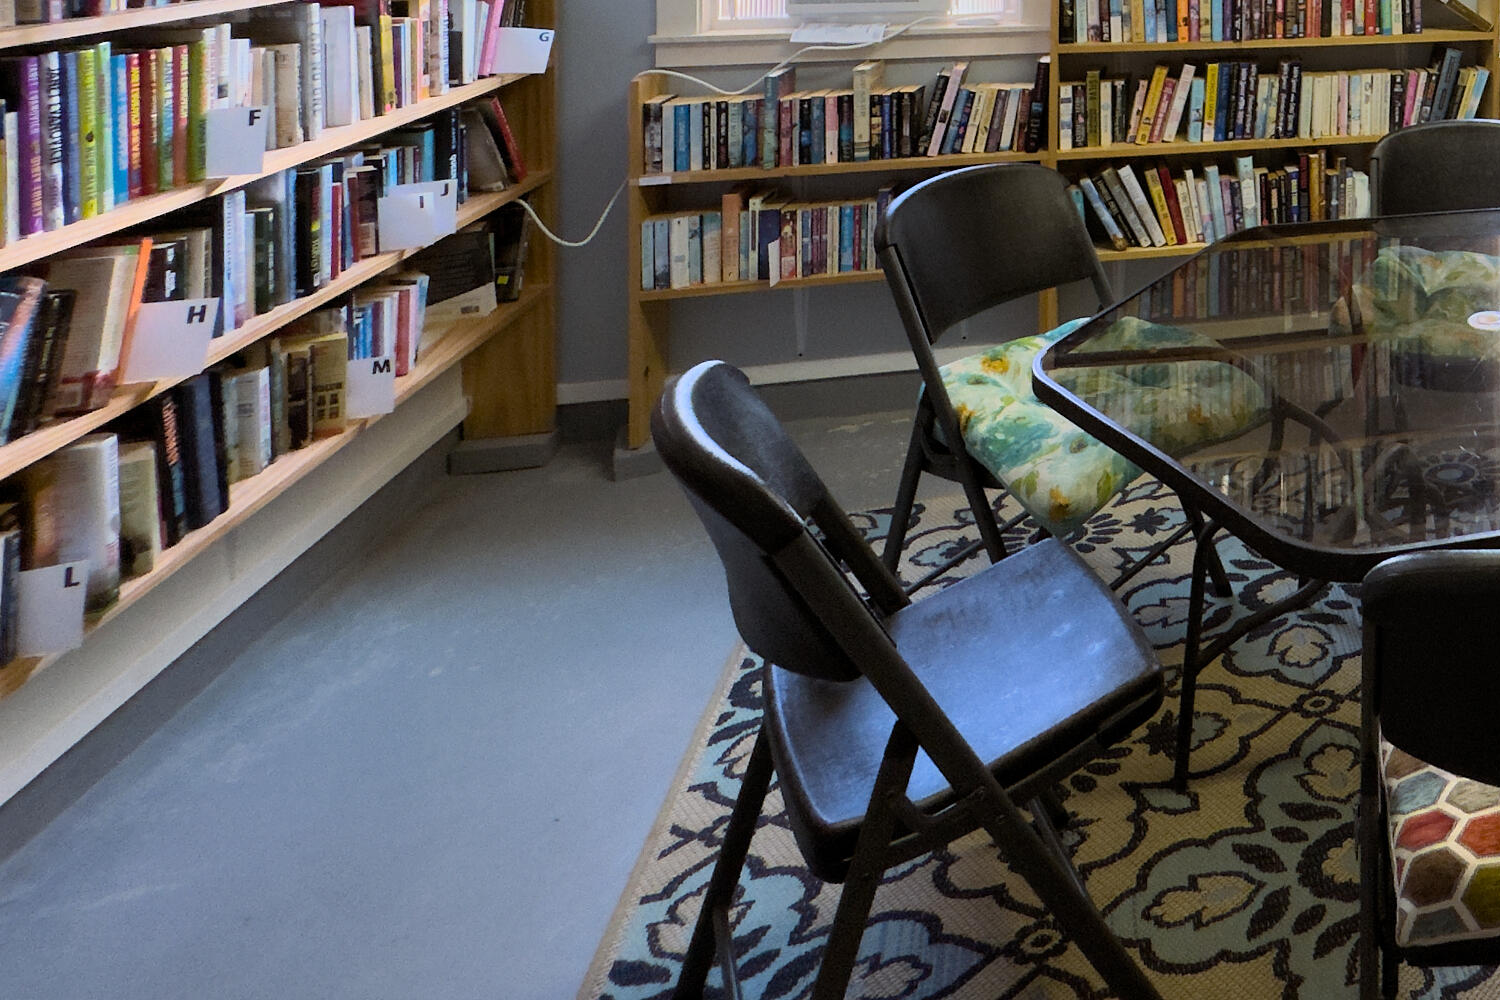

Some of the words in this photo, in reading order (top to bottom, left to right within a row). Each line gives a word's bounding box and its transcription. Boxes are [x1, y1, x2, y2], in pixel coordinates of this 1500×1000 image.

[539, 31, 550, 42] G
[248, 109, 261, 126] F
[439, 179, 450, 197] J
[186, 305, 206, 323] H
[371, 358, 391, 374] M
[63, 566, 80, 587] L
